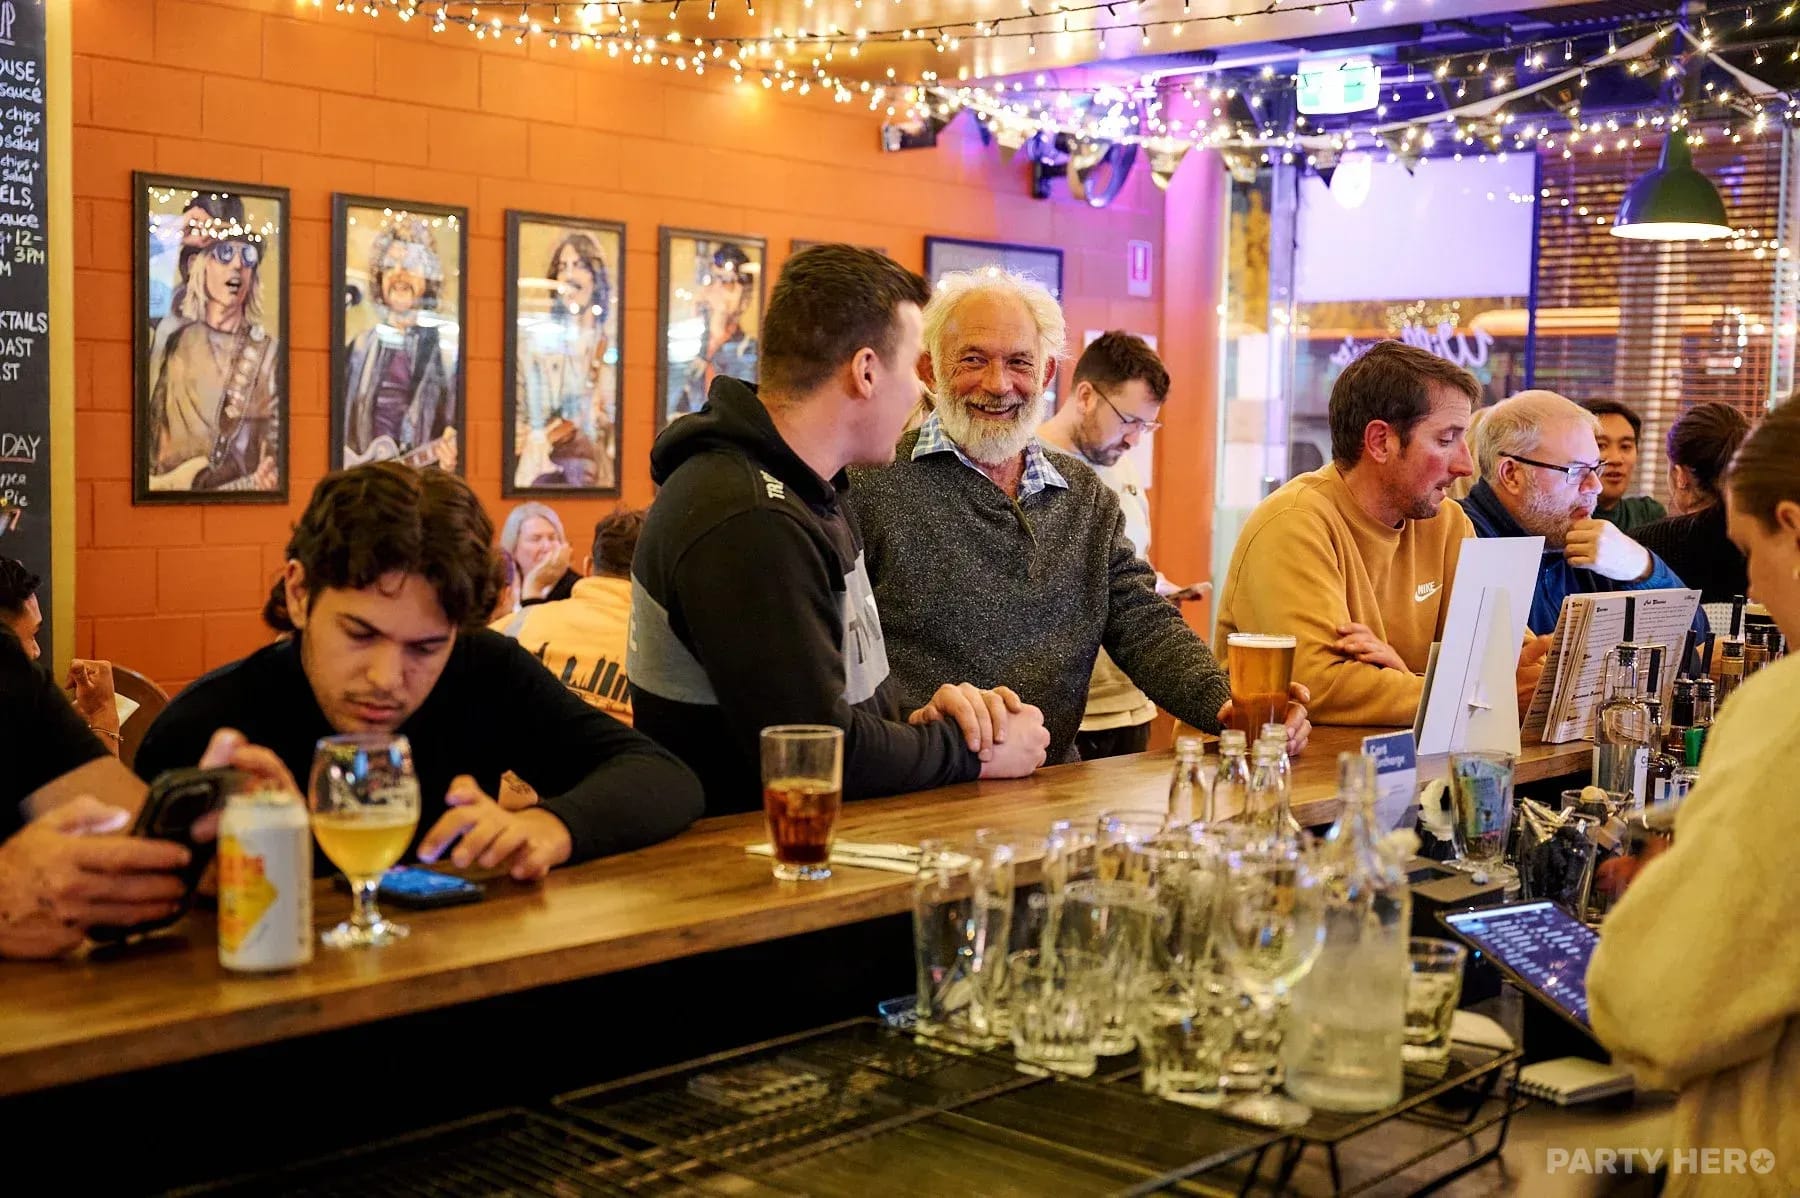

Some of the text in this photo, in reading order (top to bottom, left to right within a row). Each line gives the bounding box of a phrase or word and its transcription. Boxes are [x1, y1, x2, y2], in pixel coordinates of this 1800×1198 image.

[5, 105, 41, 127] chips
[2, 433, 41, 463] DAY
[1417, 580, 1436, 596] NIKE
